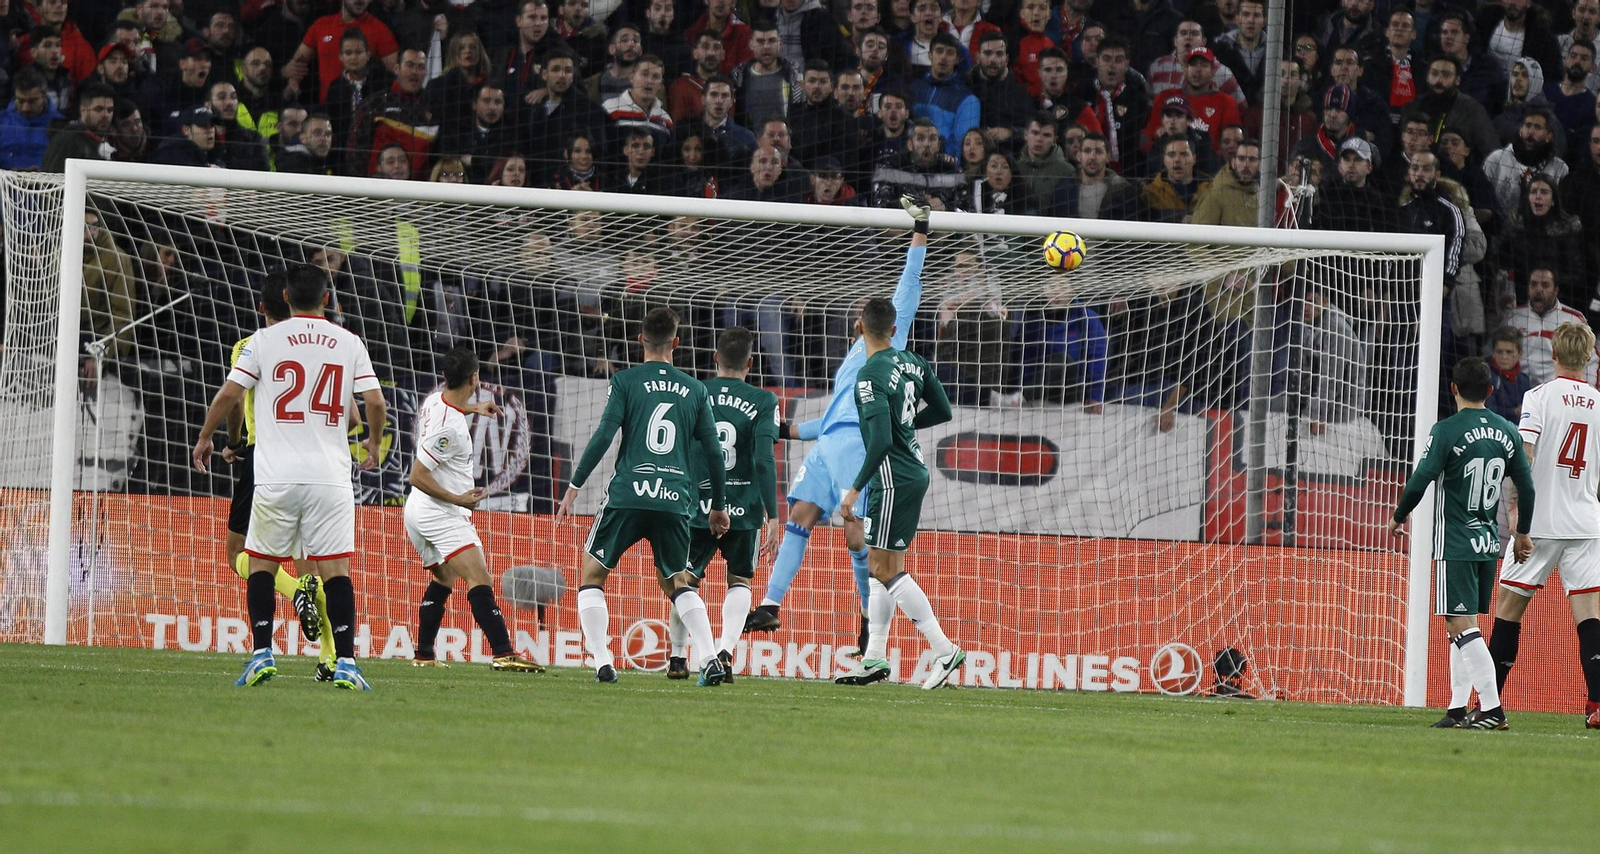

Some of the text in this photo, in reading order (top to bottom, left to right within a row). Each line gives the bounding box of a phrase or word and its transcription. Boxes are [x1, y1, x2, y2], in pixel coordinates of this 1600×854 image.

[287, 333, 338, 349] NOLITO
[272, 360, 344, 427] 24
[643, 380, 690, 398] FABIAN
[1562, 394, 1595, 410] KJÆR
[718, 393, 758, 420] GARCÍA
[645, 402, 676, 455] 6
[1556, 421, 1589, 479] 4
[632, 477, 680, 501] Wiko
[1463, 457, 1506, 511] 18
[1470, 531, 1501, 554] Wiko
[382, 626, 614, 669] ARLNE
